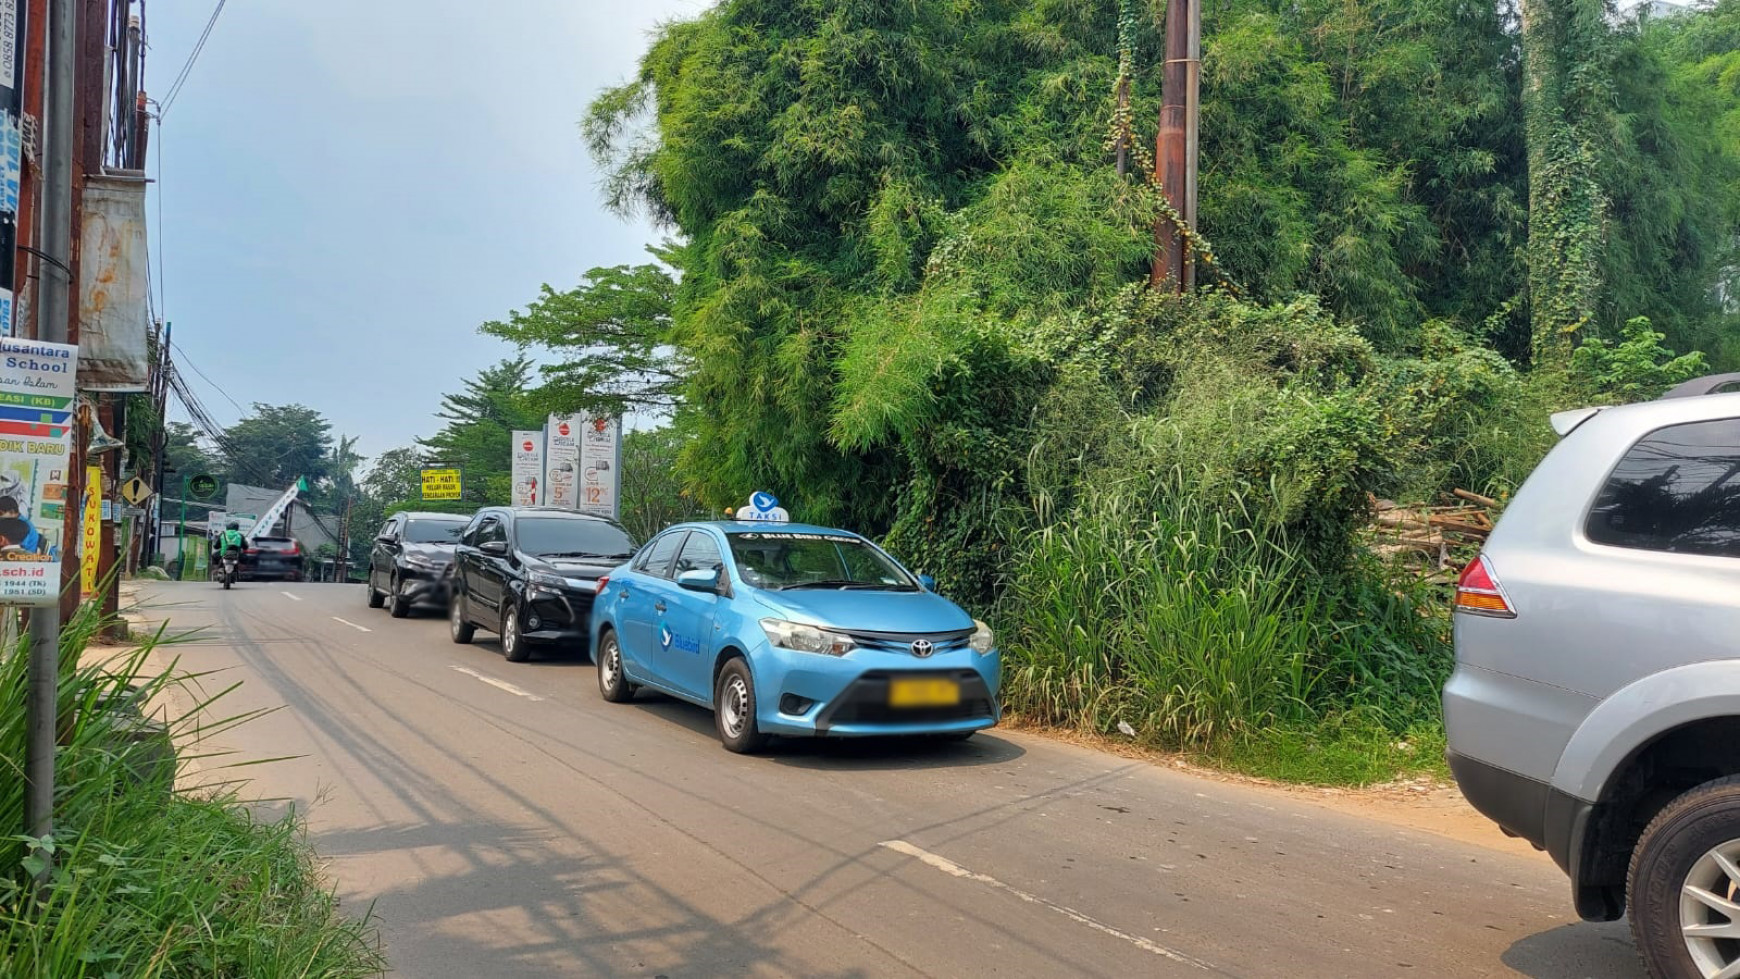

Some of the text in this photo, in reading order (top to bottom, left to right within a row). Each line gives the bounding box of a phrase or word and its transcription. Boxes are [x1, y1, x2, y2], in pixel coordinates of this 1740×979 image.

[4, 12, 13, 39] 8773
[3, 41, 13, 70] 0858
[0, 343, 70, 359] usantara
[6, 357, 68, 374] School
[31, 396, 55, 408] (KB)
[27, 441, 65, 457] BARU
[586, 486, 600, 503] 12
[749, 511, 782, 521] TAKSI
[85, 486, 97, 590] SUKOWATI
[7, 552, 53, 562] Creation
[29, 580, 47, 588] (TK)
[28, 589, 47, 597] (SD)
[675, 633, 700, 655] Bluebird
